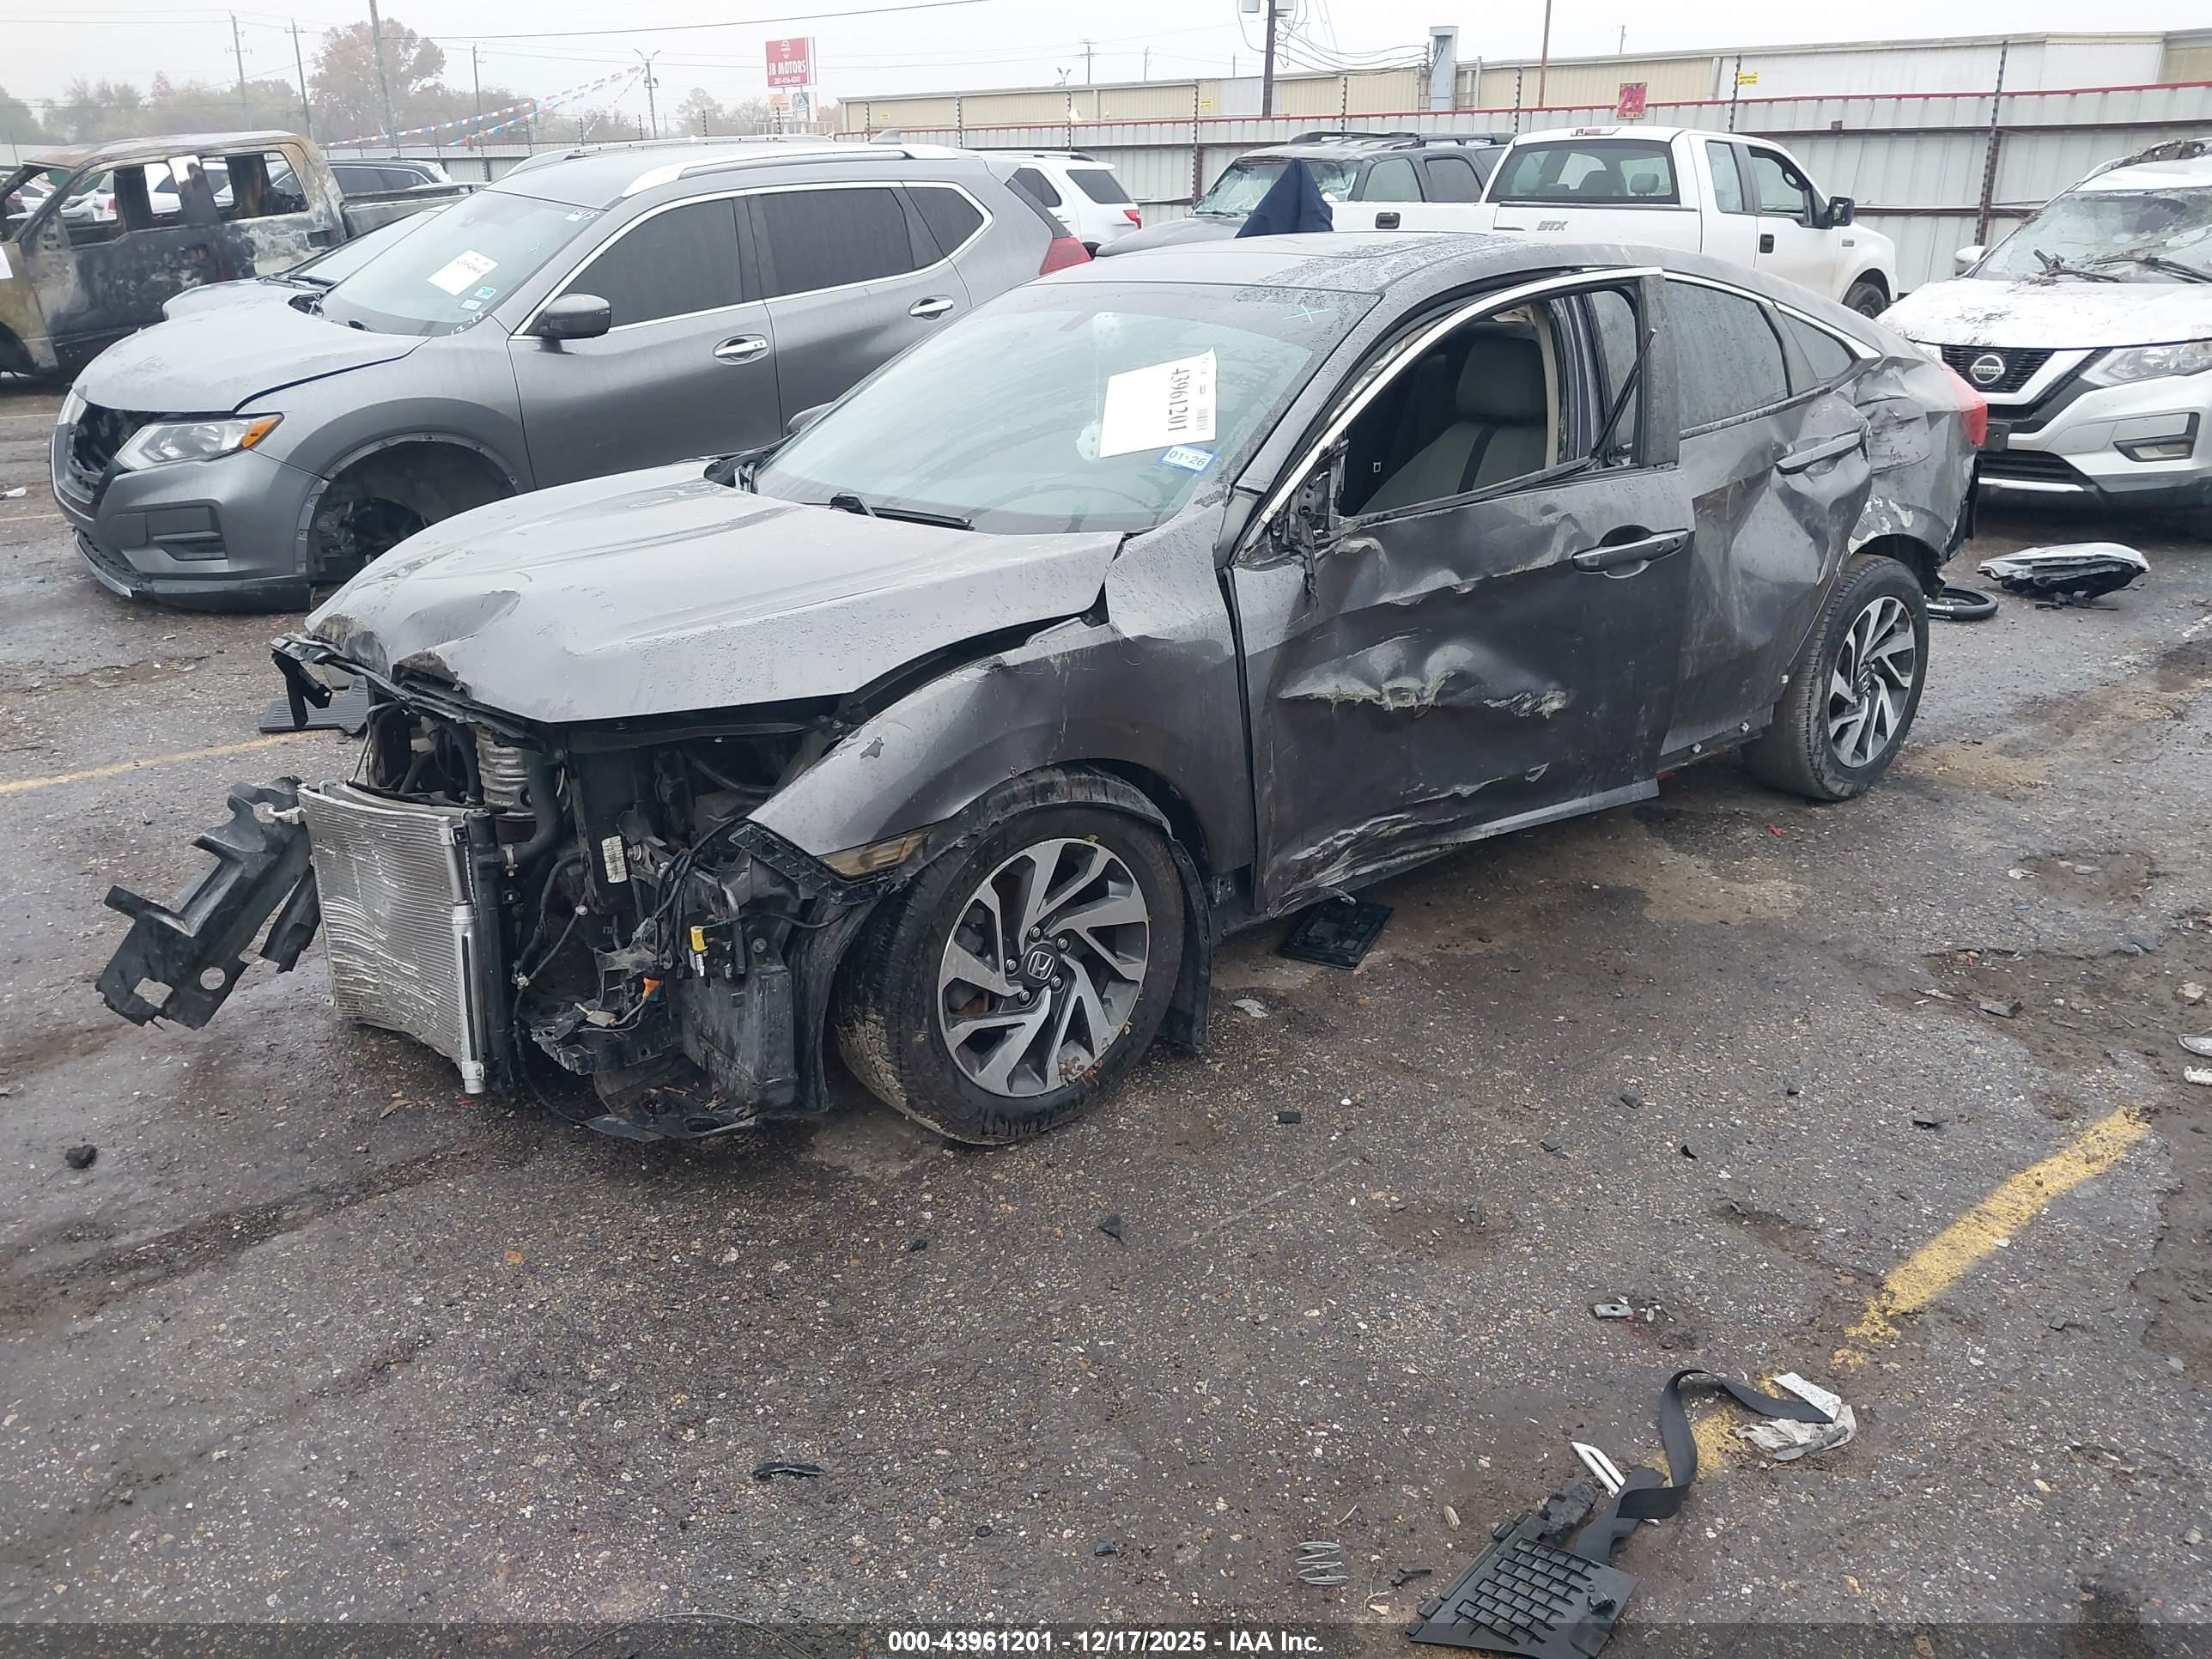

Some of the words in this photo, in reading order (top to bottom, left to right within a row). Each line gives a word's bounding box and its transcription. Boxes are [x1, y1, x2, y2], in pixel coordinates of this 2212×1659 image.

[769, 62, 777, 76] JB
[777, 59, 806, 76] MOTORS
[1537, 220, 1569, 231] STX
[1168, 368, 1191, 433] 43961201
